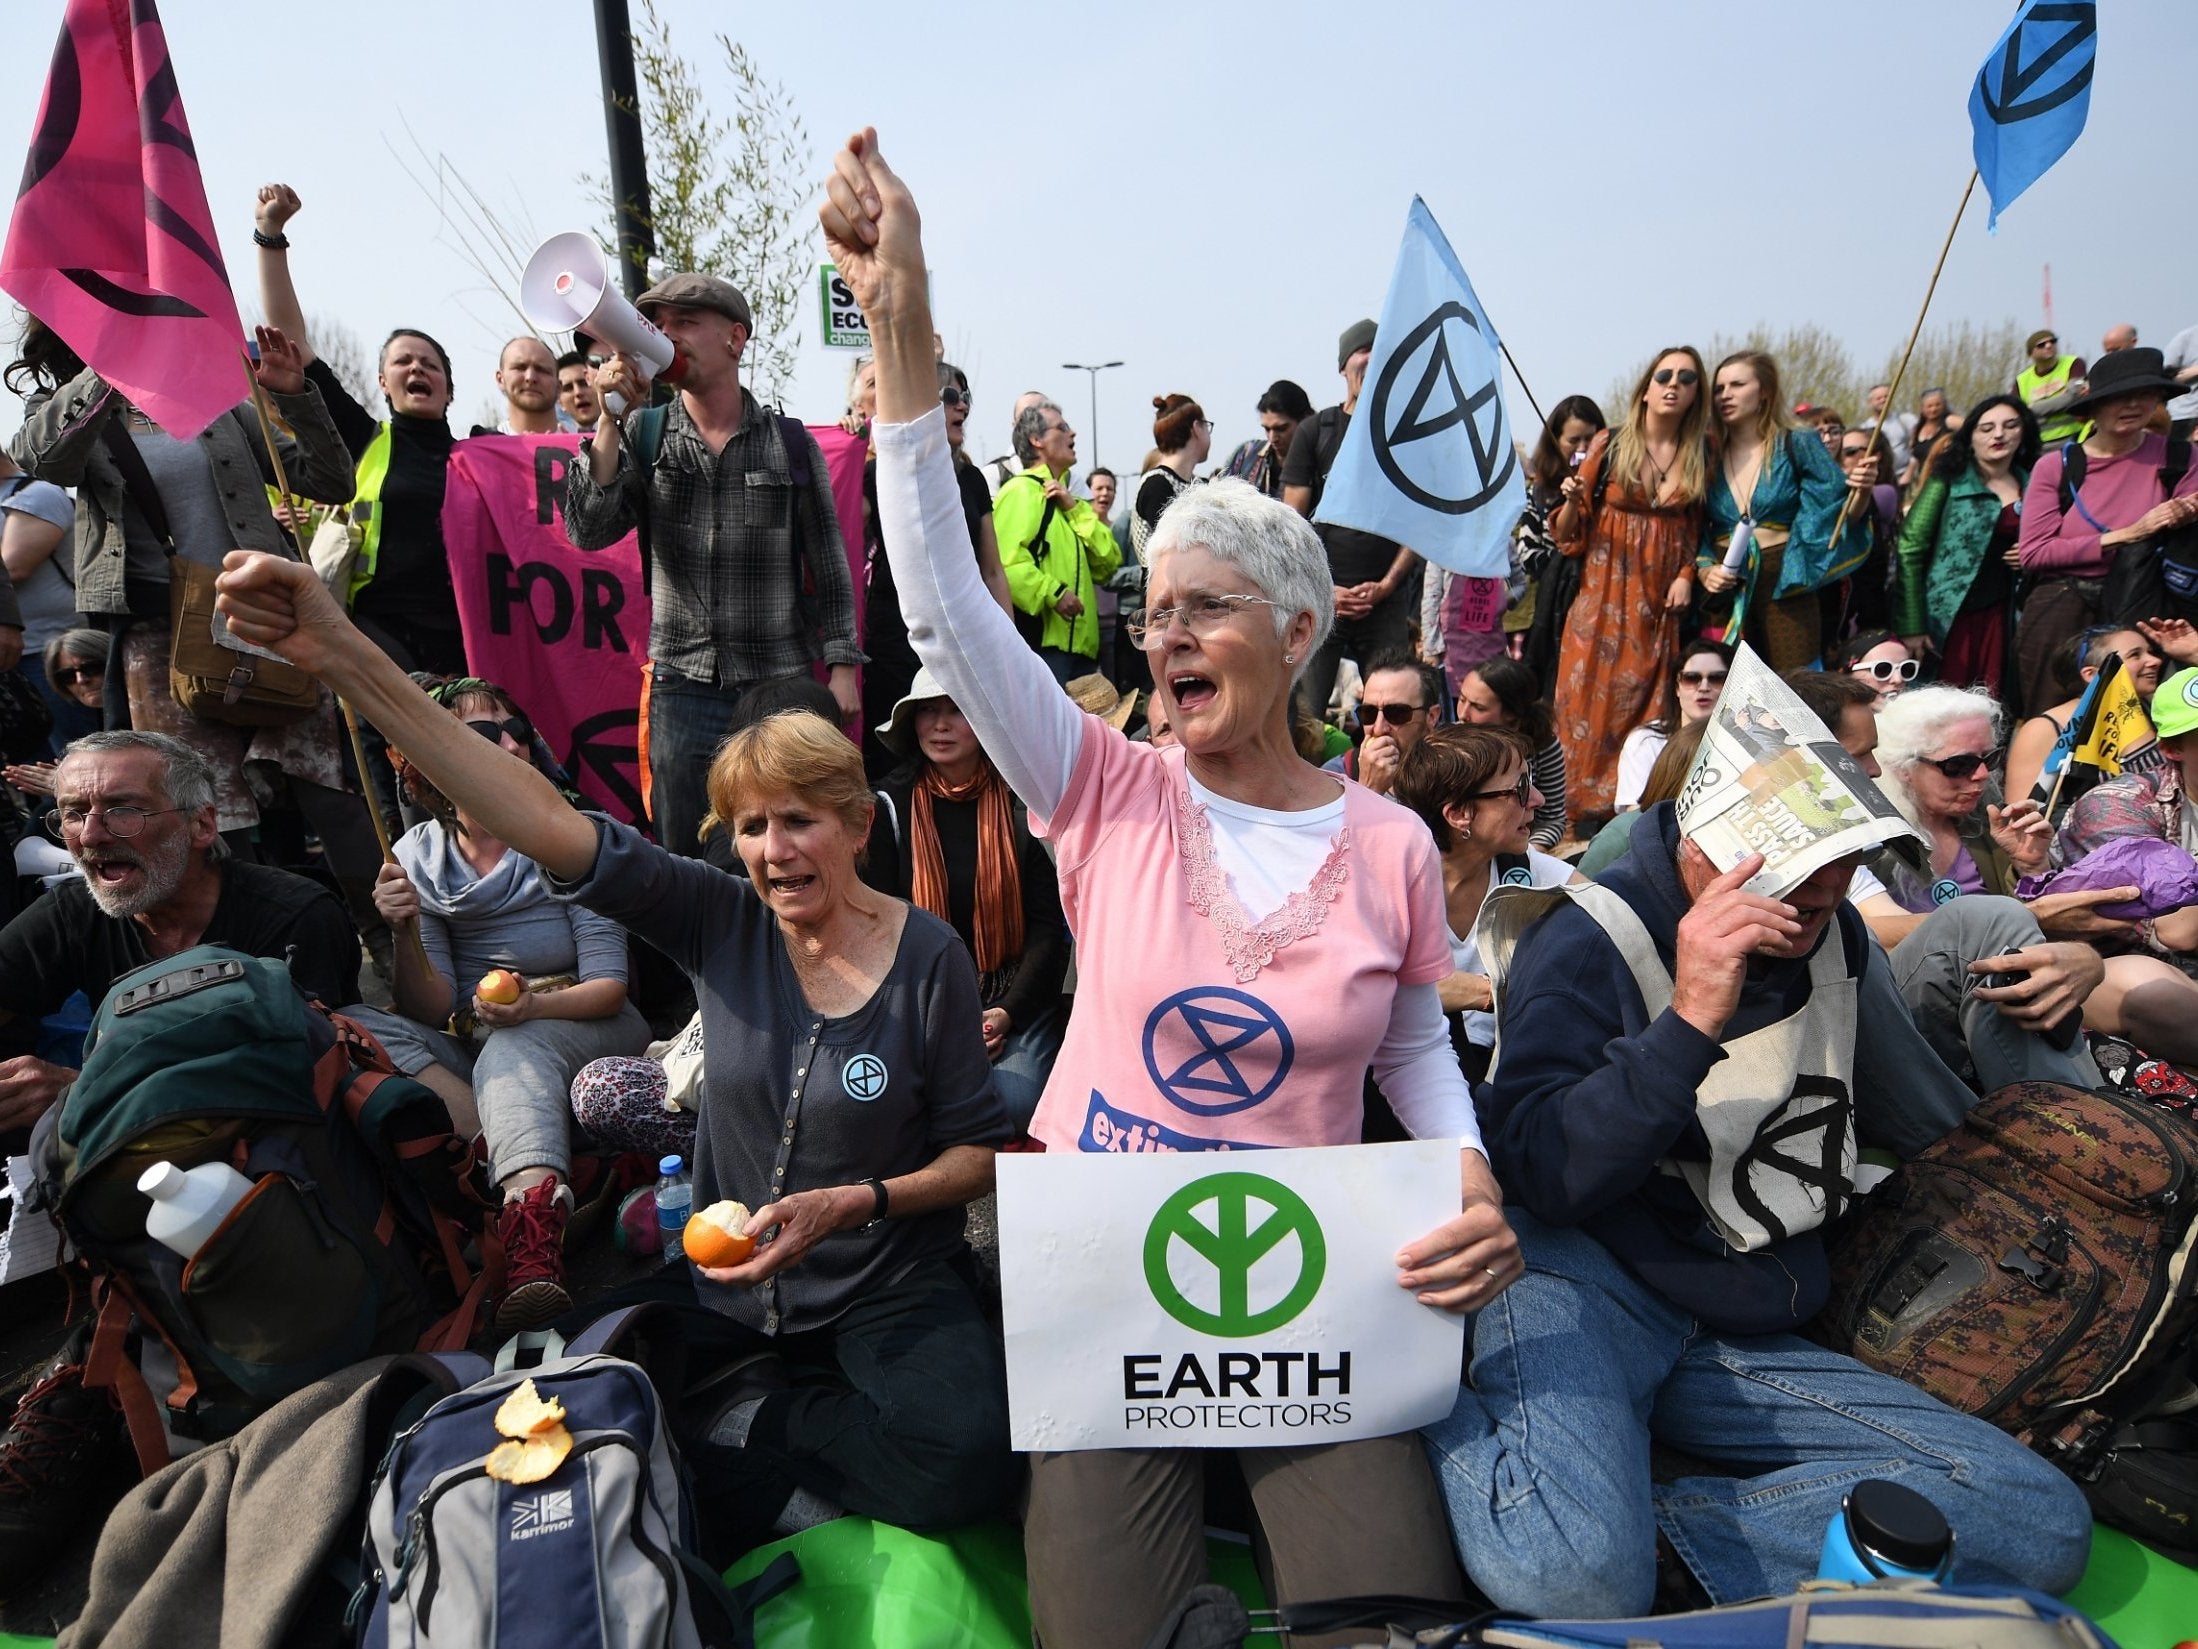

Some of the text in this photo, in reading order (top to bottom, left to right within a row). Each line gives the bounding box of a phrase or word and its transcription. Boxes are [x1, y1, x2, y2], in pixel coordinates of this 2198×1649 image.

[831, 278, 859, 308] S
[830, 334, 872, 347] chang
[535, 446, 576, 525] R
[486, 552, 630, 654] FOR
[1465, 611, 1488, 623] LIFE
[1724, 800, 1757, 830] TH
[1123, 1351, 1351, 1400] EARTH
[1125, 1401, 1352, 1430] PROTECTORS
[511, 1518, 575, 1541] karrimor
